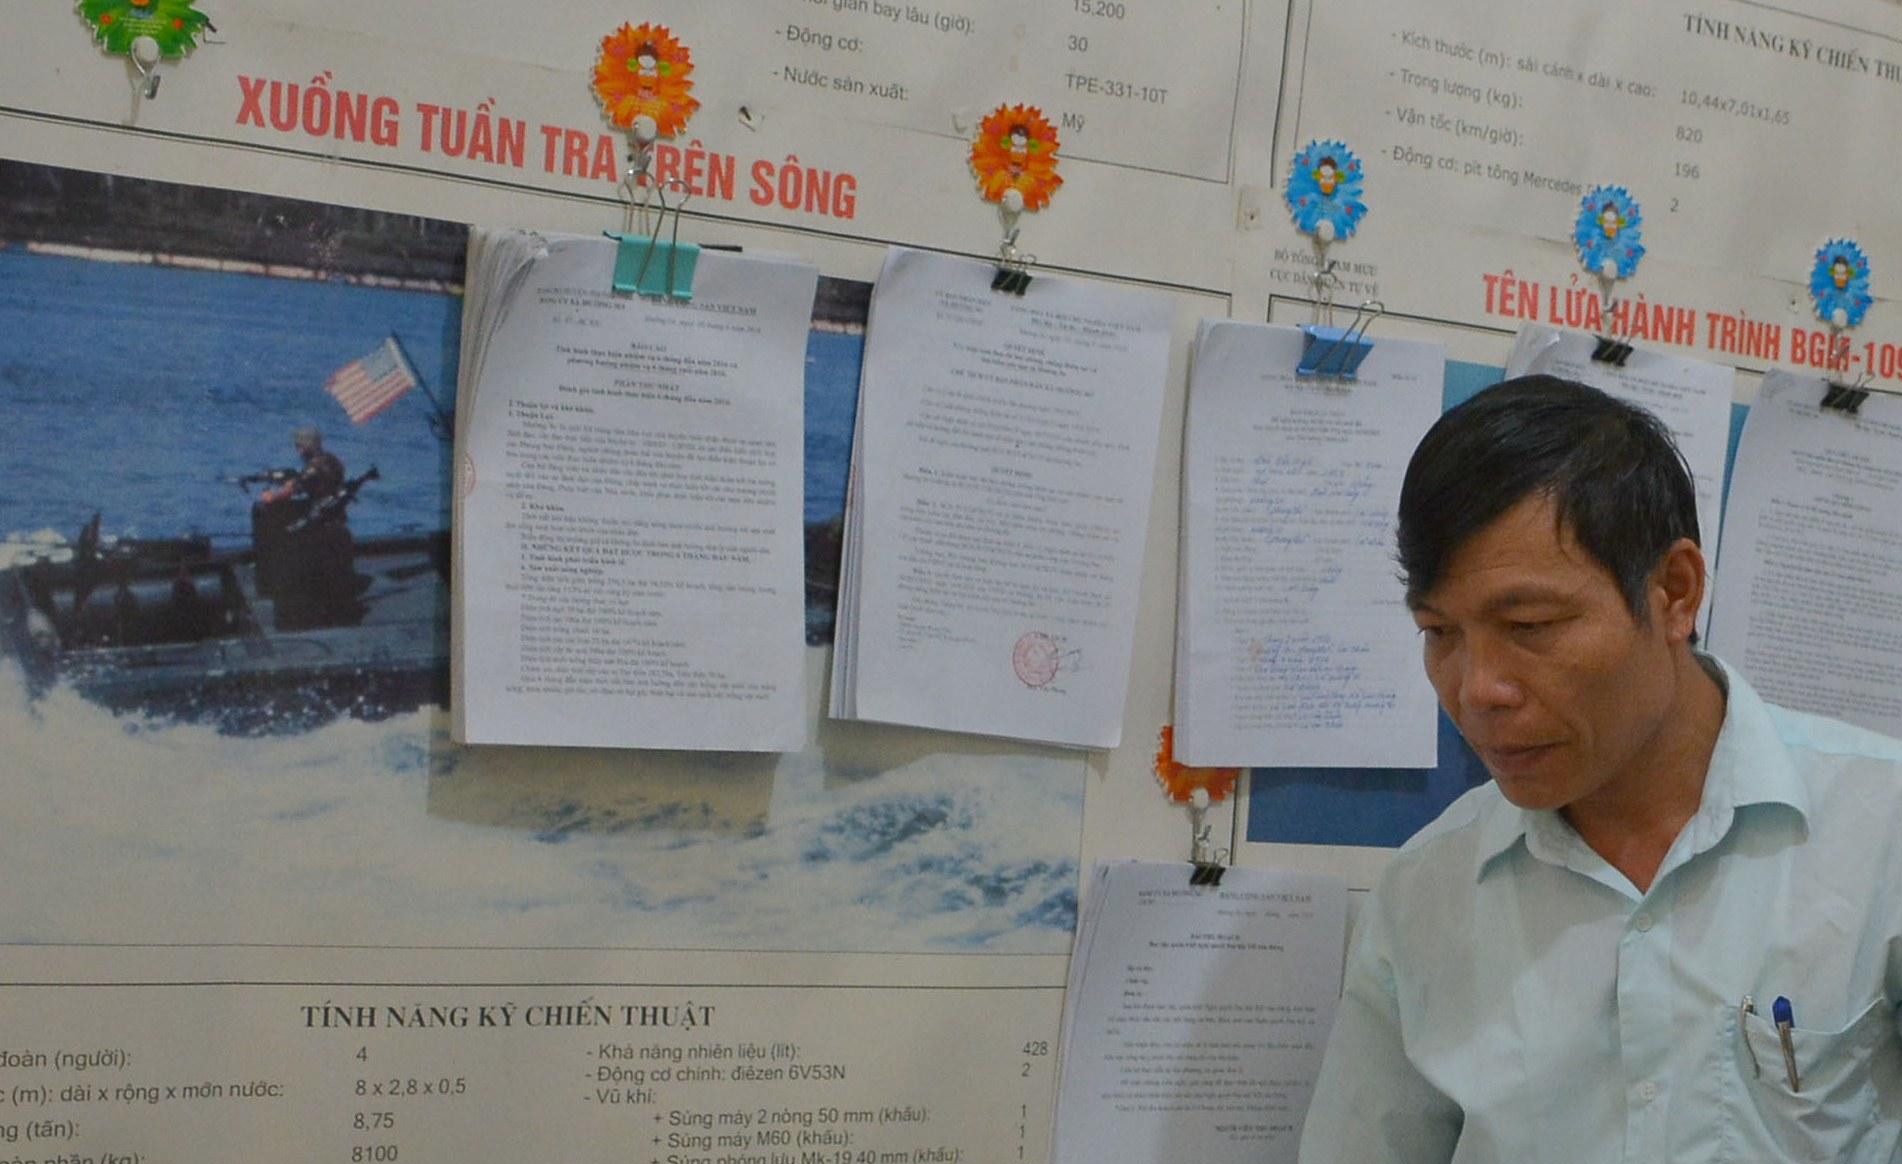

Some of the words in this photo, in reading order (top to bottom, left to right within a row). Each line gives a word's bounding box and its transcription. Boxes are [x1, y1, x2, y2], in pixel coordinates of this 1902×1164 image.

[873, 1, 901, 21] bay
[1683, 12, 1729, 41] TÍNH
[786, 24, 833, 51] Động
[837, 37, 863, 53] cơ:
[1067, 35, 1089, 52] 30
[1401, 29, 1430, 49] Kích
[1478, 48, 1511, 69] (m):
[1627, 81, 1657, 98] cao:
[783, 65, 828, 89] Nước
[833, 75, 865, 95] sản
[869, 78, 908, 101] xuất:
[1064, 73, 1168, 105] TPE-331-10T
[1400, 68, 1439, 93] Trọng
[1443, 79, 1482, 103] lượng
[1486, 87, 1523, 109] (kg):
[1062, 112, 1086, 132] Mỹ
[1455, 119, 1525, 147] (km/giờ):
[1675, 126, 1703, 144] 820
[236, 69, 400, 147] XUỒNG
[416, 96, 527, 168] TUẦN
[540, 123, 617, 183] TRA
[749, 154, 857, 220] SÔNG
[1392, 144, 1433, 169] Động
[1437, 153, 1458, 172] cơ:
[1524, 170, 1582, 196] Mercedes
[1674, 162, 1700, 179] 196
[1669, 198, 1680, 213] 2
[1482, 268, 1540, 321] TÊN
[1550, 273, 1602, 332] LỬA
[1611, 292, 1697, 347] HÀNH
[1706, 309, 1782, 361] TRÌNH
[300, 1000, 377, 1029] TÍNH
[386, 1003, 468, 1029] NĂNG
[478, 1001, 517, 1028] KỸ
[525, 996, 612, 1028] CHIẾN
[620, 1001, 716, 1032] THUẬT
[356, 1045, 369, 1062] 4
[598, 1043, 634, 1061] Khả
[640, 1045, 682, 1063] năng
[687, 1044, 733, 1061] nhiên
[1022, 1041, 1049, 1057] 428
[54, 1048, 132, 1071] (người):
[597, 1065, 645, 1086] Động
[651, 1068, 671, 1082] cơ
[676, 1067, 727, 1082] chính:
[788, 1063, 846, 1081] 6V53N
[1021, 1063, 1031, 1078] 2
[12, 1085, 53, 1107] (m):
[60, 1084, 91, 1102] dài
[98, 1089, 108, 1101] x
[115, 1083, 160, 1106] rộng
[166, 1087, 176, 1099] x
[229, 1080, 285, 1098] nước:
[355, 1080, 368, 1096] 8
[372, 1083, 384, 1096] x
[388, 1079, 418, 1099] 2,8
[423, 1082, 434, 1095] x
[596, 1088, 621, 1105] Vũ
[626, 1088, 657, 1105] khí:
[668, 1110, 713, 1129] Súng
[718, 1109, 752, 1129] máy
[757, 1108, 767, 1124] 2
[771, 1108, 813, 1128] nòng
[818, 1107, 839, 1123] 50
[844, 1111, 874, 1123] mm
[1020, 1103, 1027, 1118] 1
[26, 1118, 80, 1142] (tấn):
[353, 1111, 395, 1131] 8,75
[667, 1132, 712, 1152] Súng
[717, 1131, 752, 1151] máy
[757, 1131, 791, 1146] M60
[1019, 1124, 1026, 1139] 1
[351, 1144, 399, 1163] 8100
[856, 1149, 876, 1164] 40
[880, 1153, 908, 1164] mm
[1017, 1145, 1024, 1160] 1
